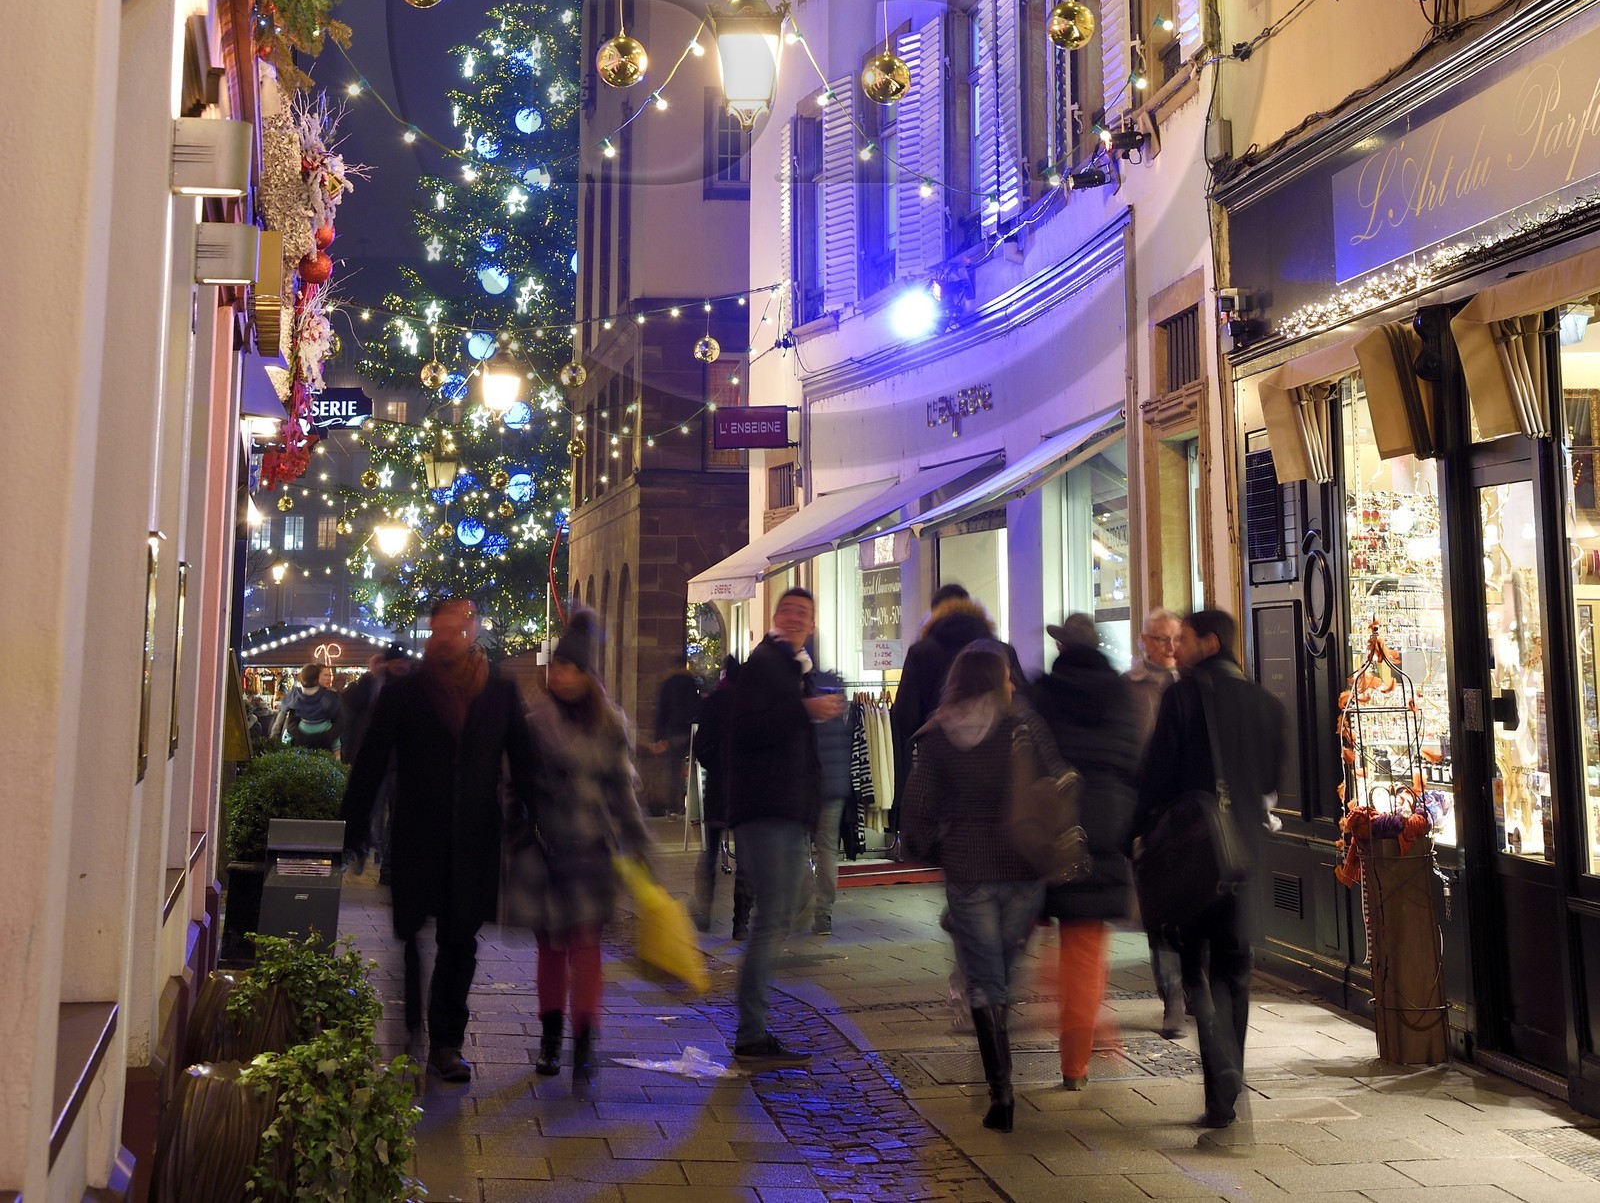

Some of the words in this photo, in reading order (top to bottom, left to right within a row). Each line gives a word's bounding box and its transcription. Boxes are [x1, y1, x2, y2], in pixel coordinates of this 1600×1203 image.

[1350, 116, 1454, 246] L'Art
[1456, 124, 1492, 199] du
[303, 400, 358, 417] SERIE
